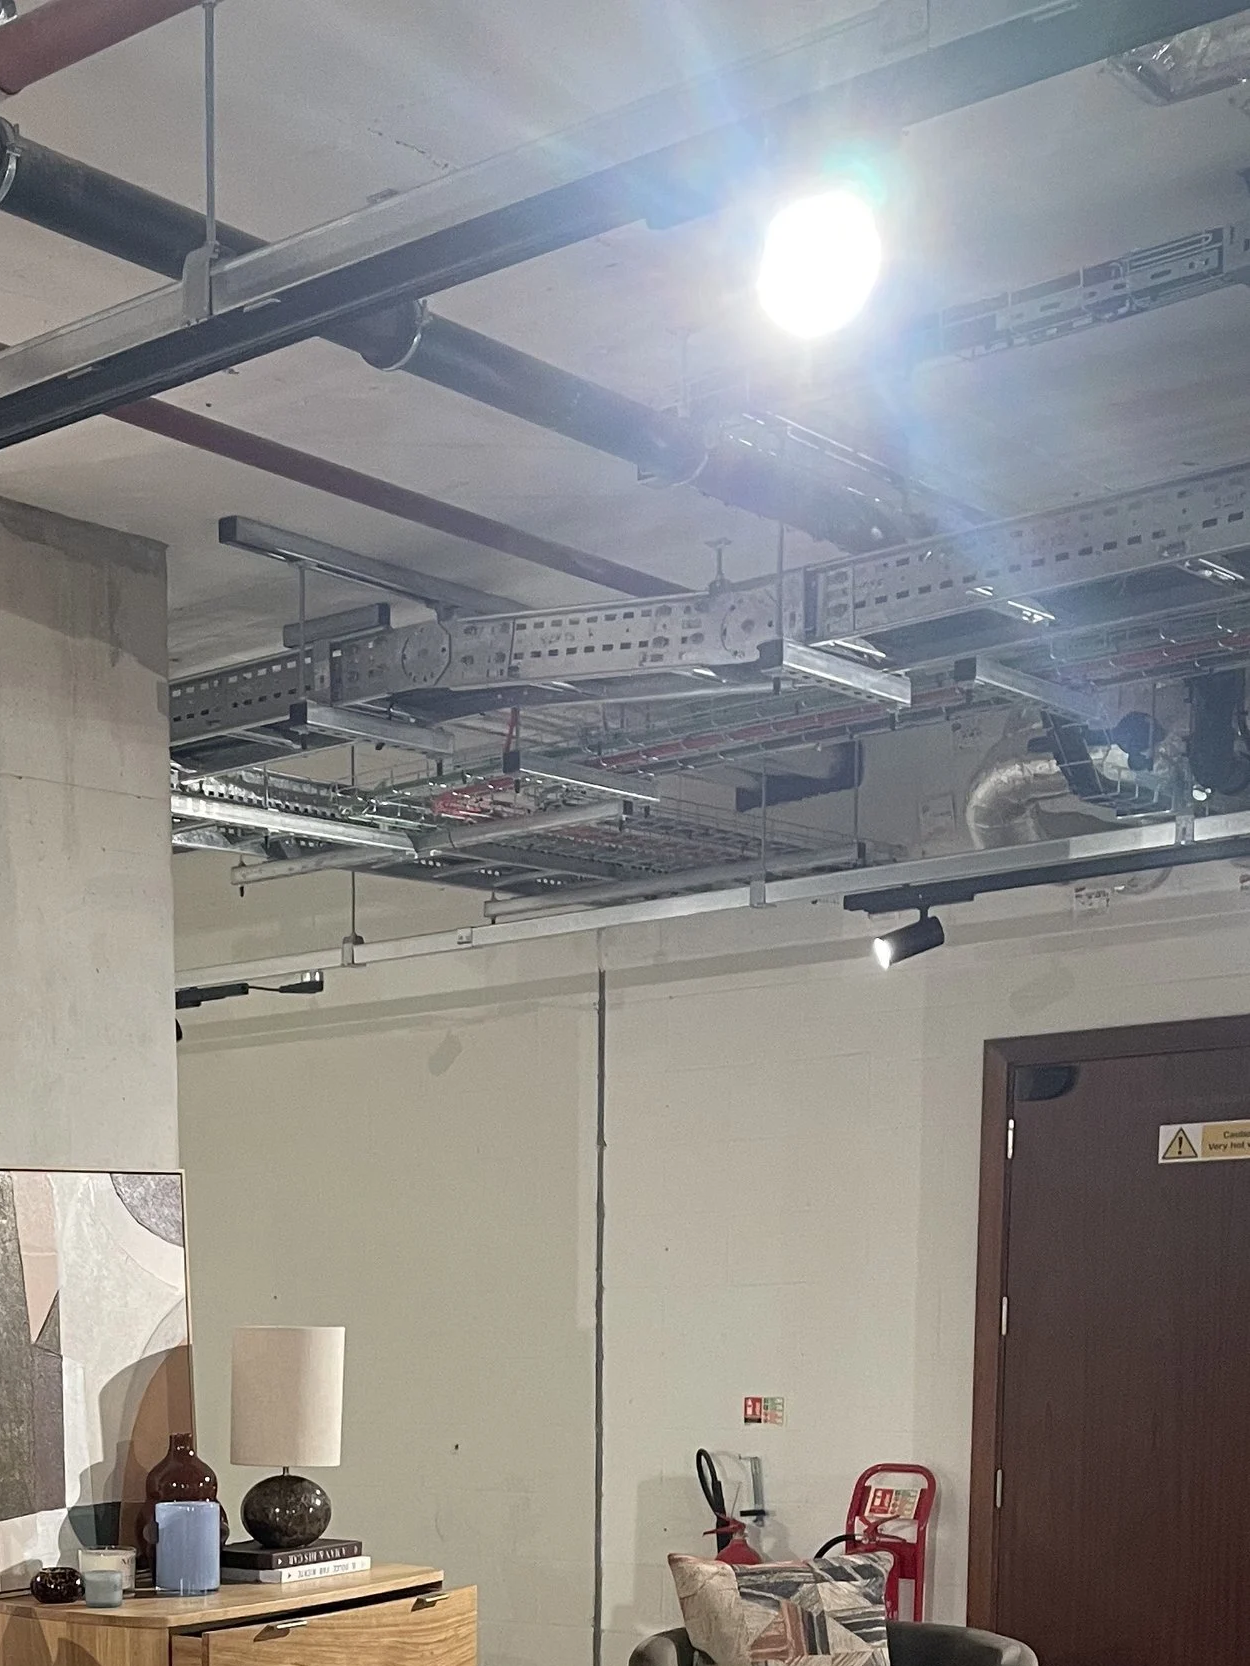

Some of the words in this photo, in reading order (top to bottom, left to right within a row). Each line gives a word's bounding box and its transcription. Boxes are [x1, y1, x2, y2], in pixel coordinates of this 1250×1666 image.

[1208, 1143, 1228, 1152] Very
[288, 1553, 303, 1565] CAR
[304, 1551, 317, 1562] HIS
[326, 1548, 341, 1559] MAN
